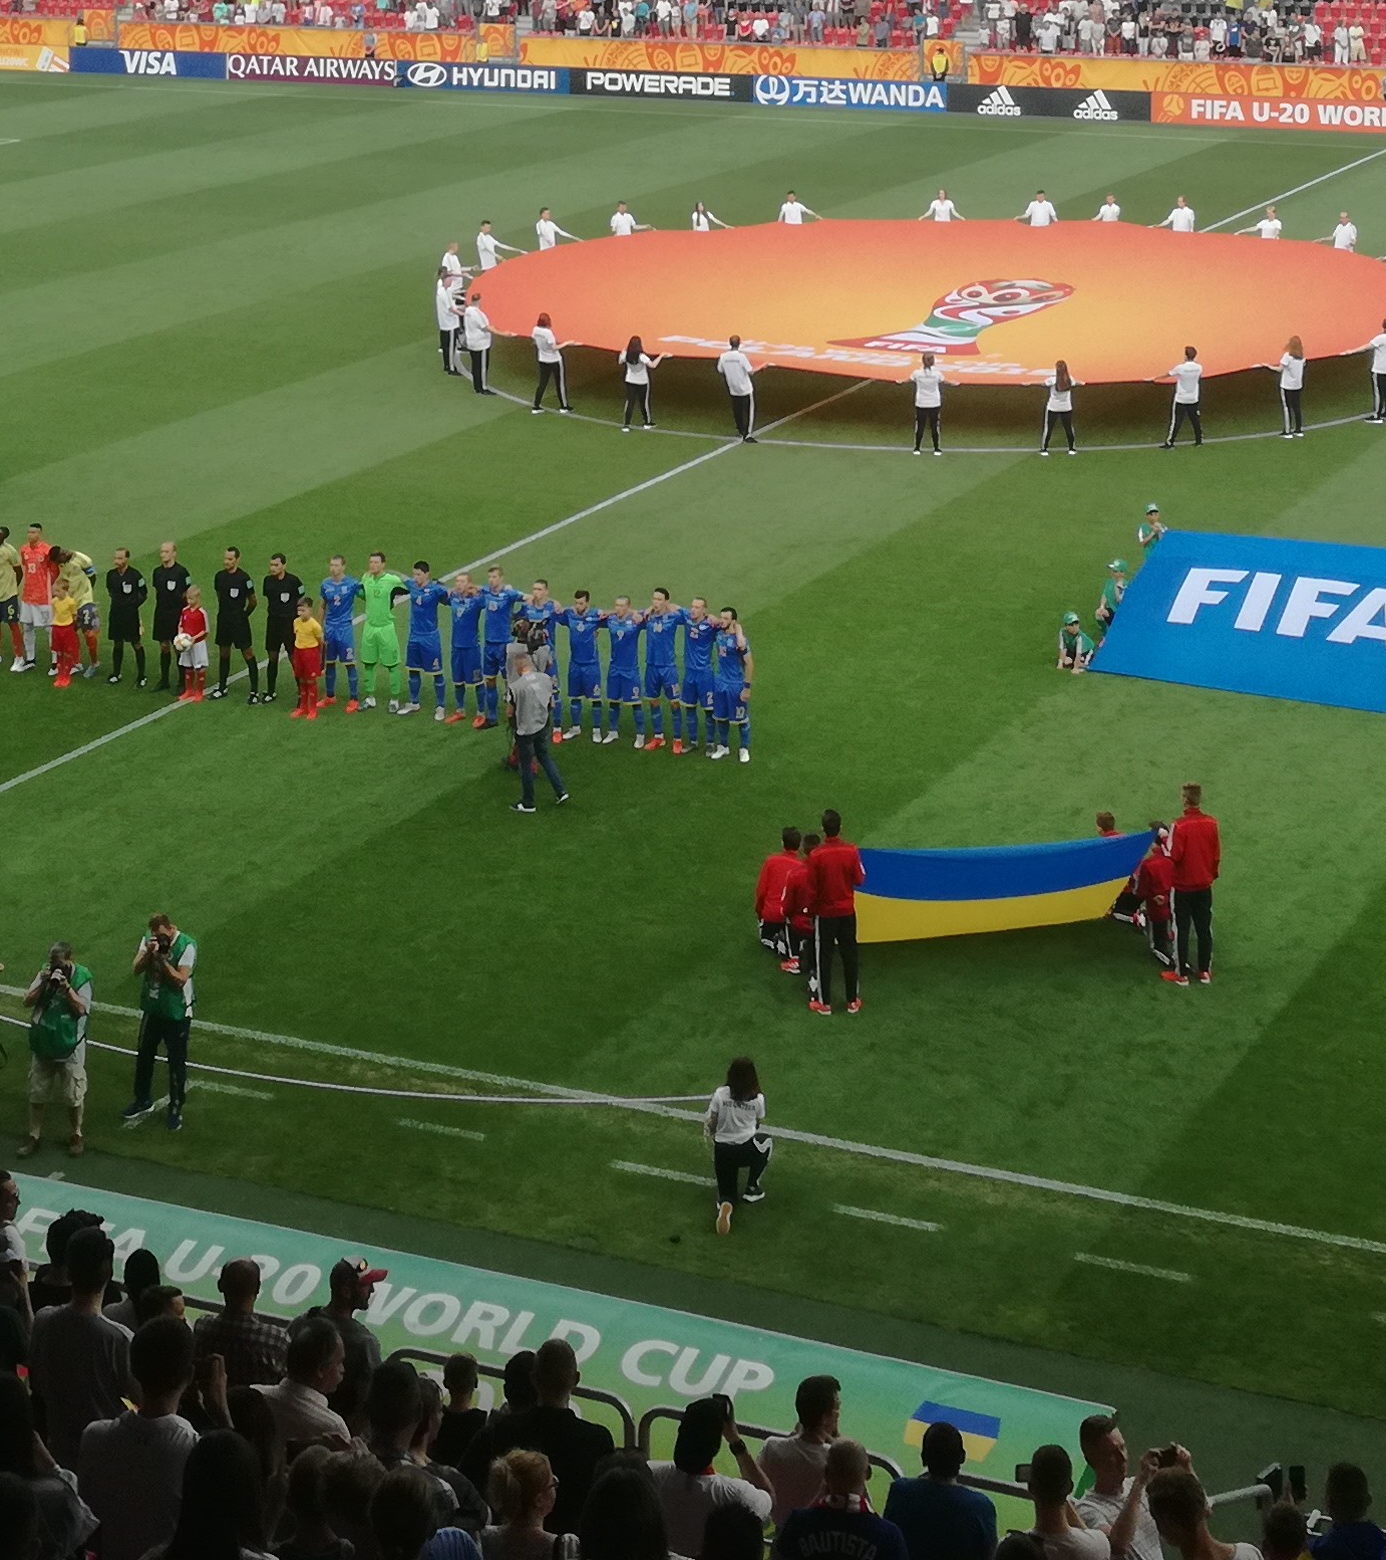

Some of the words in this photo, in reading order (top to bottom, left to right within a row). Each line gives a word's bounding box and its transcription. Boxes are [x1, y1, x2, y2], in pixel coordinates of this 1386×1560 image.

[119, 50, 177, 77] VISA
[228, 54, 299, 81] QATAR
[304, 57, 396, 81] AIRWAYS
[453, 67, 557, 90] HYUNDAI
[587, 71, 730, 97] POWERADE
[847, 83, 944, 109] WANDA
[977, 102, 1022, 116] adidas
[1073, 105, 1118, 120] adidas
[1190, 99, 1245, 122] FIFA
[1251, 102, 1309, 124] U-20
[863, 340, 946, 354] FIFA
[621, 1339, 775, 1400] CUP
